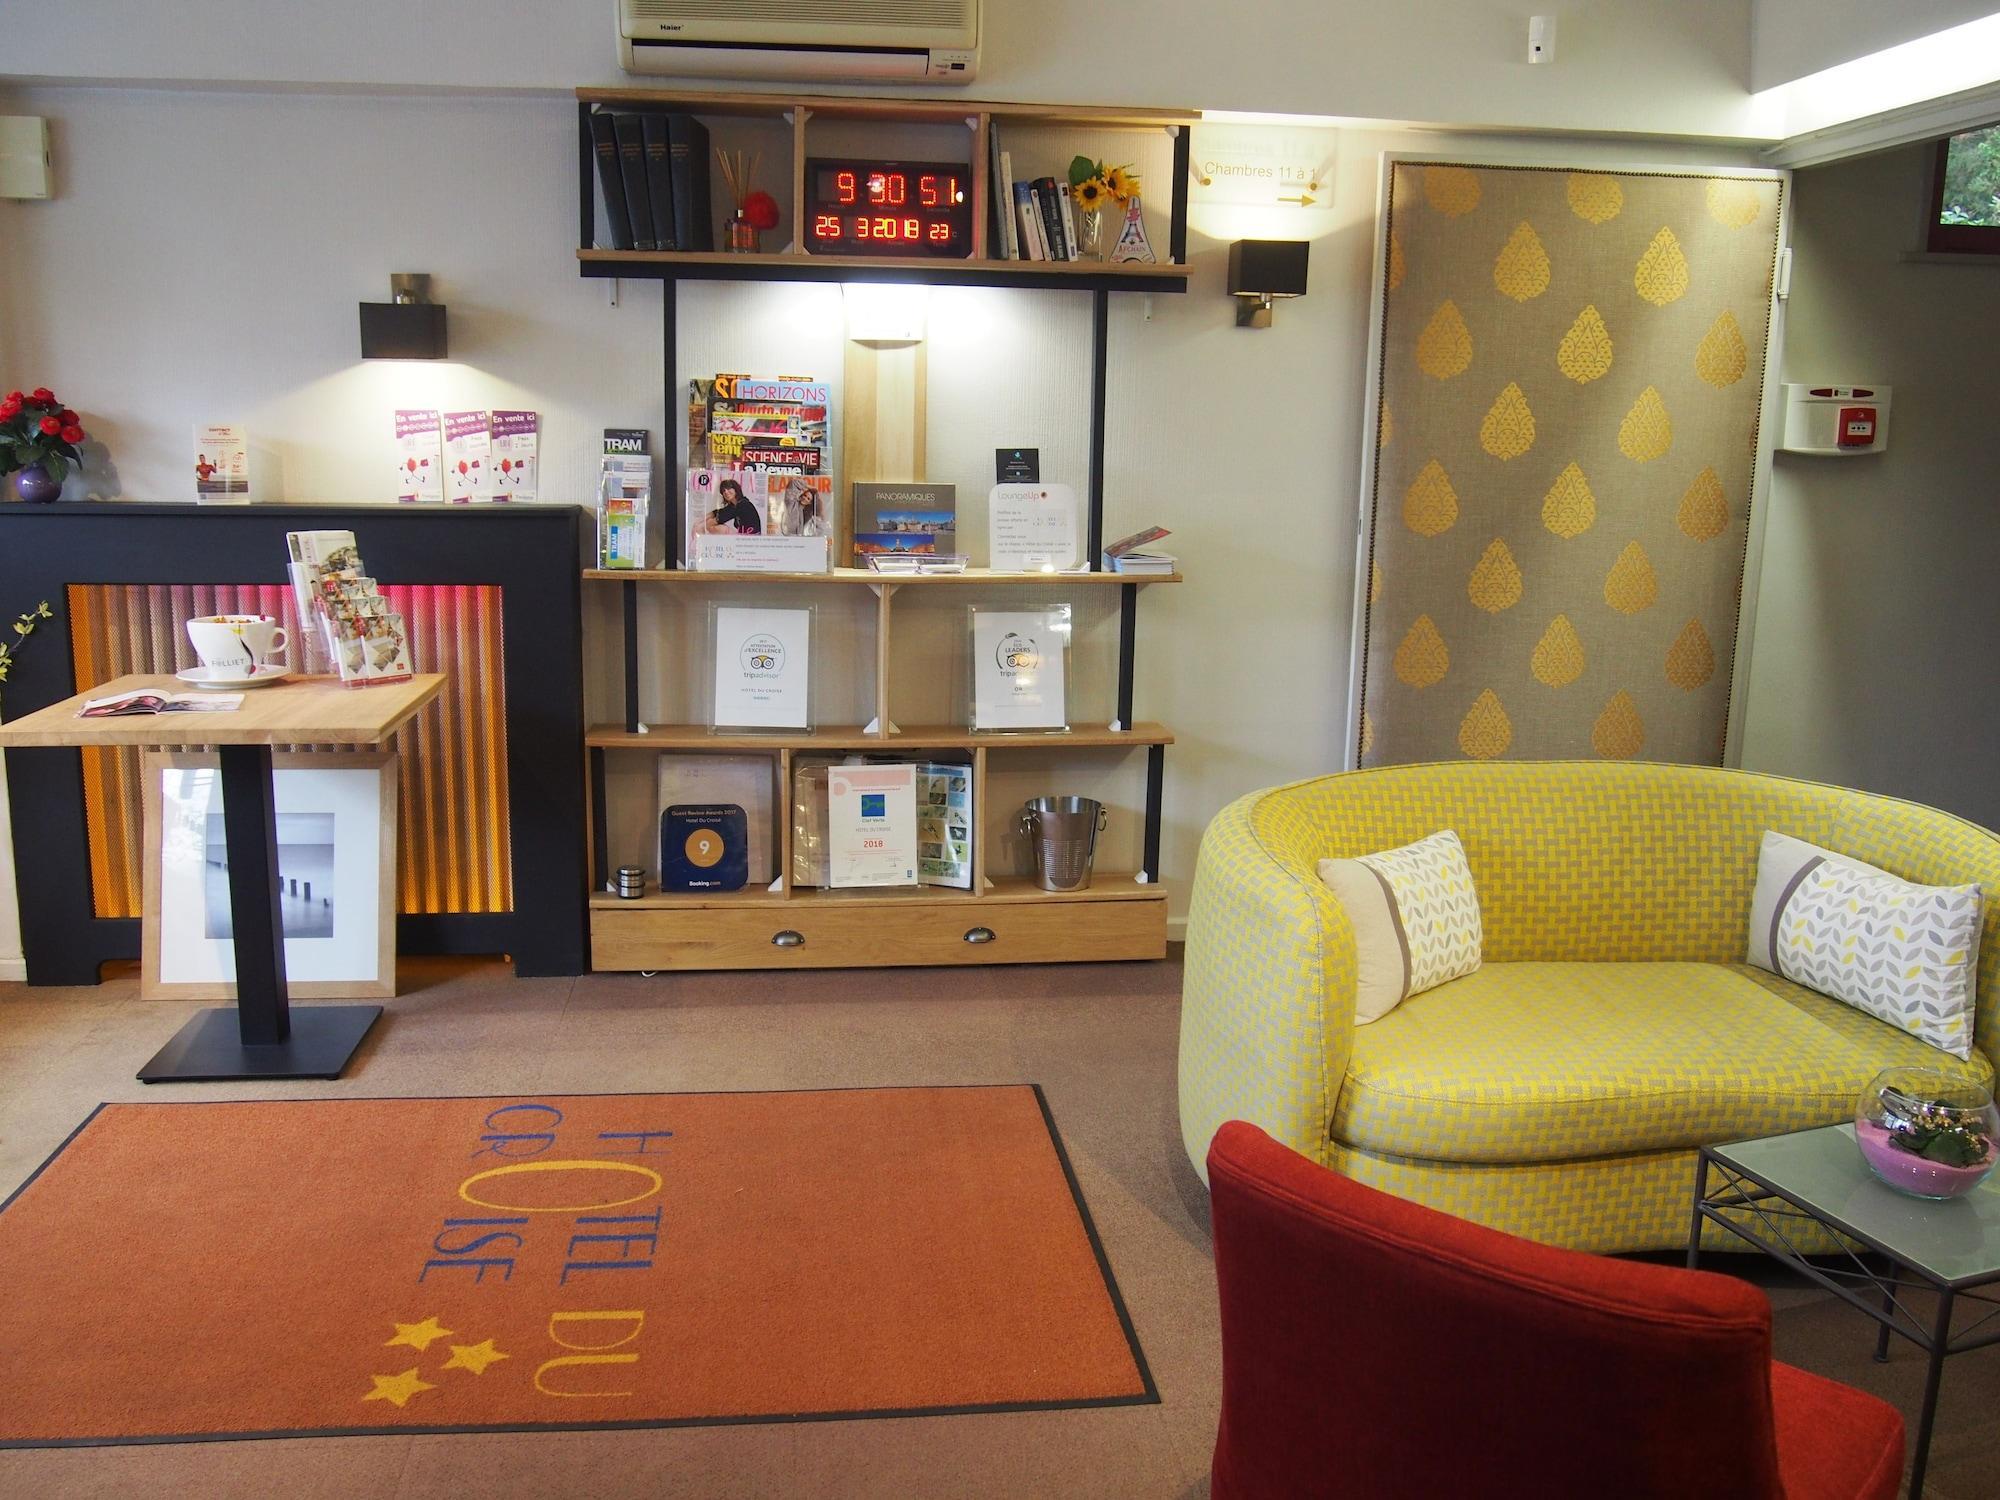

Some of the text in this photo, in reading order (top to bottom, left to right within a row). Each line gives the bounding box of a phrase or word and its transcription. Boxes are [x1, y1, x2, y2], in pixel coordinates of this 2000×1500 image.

[1204, 161, 1273, 177] Chambres
[1279, 167, 1292, 178] 11
[1296, 167, 1305, 179] à
[920, 175, 957, 205] 51
[815, 215, 841, 237] 25
[857, 217, 869, 238] 3
[873, 218, 920, 239] 2018
[929, 224, 950, 240] 23
[742, 385, 827, 402] HORIZONS
[396, 415, 405, 423] En
[408, 413, 428, 422] vente
[445, 413, 486, 426] En vente ici
[492, 413, 535, 423] En vente ici
[604, 438, 642, 451] TRAM
[711, 434, 746, 446] Notre
[711, 443, 742, 457] temp
[745, 451, 793, 464] SCIENCE
[798, 453, 817, 466] VIE
[755, 463, 802, 476] Revue
[875, 492, 936, 502] PANORAMIQUES
[743, 671, 780, 679] tripadvisor
[699, 840, 710, 855] 9
[863, 840, 884, 848] 2018
[533, 1309, 645, 1398] DU
